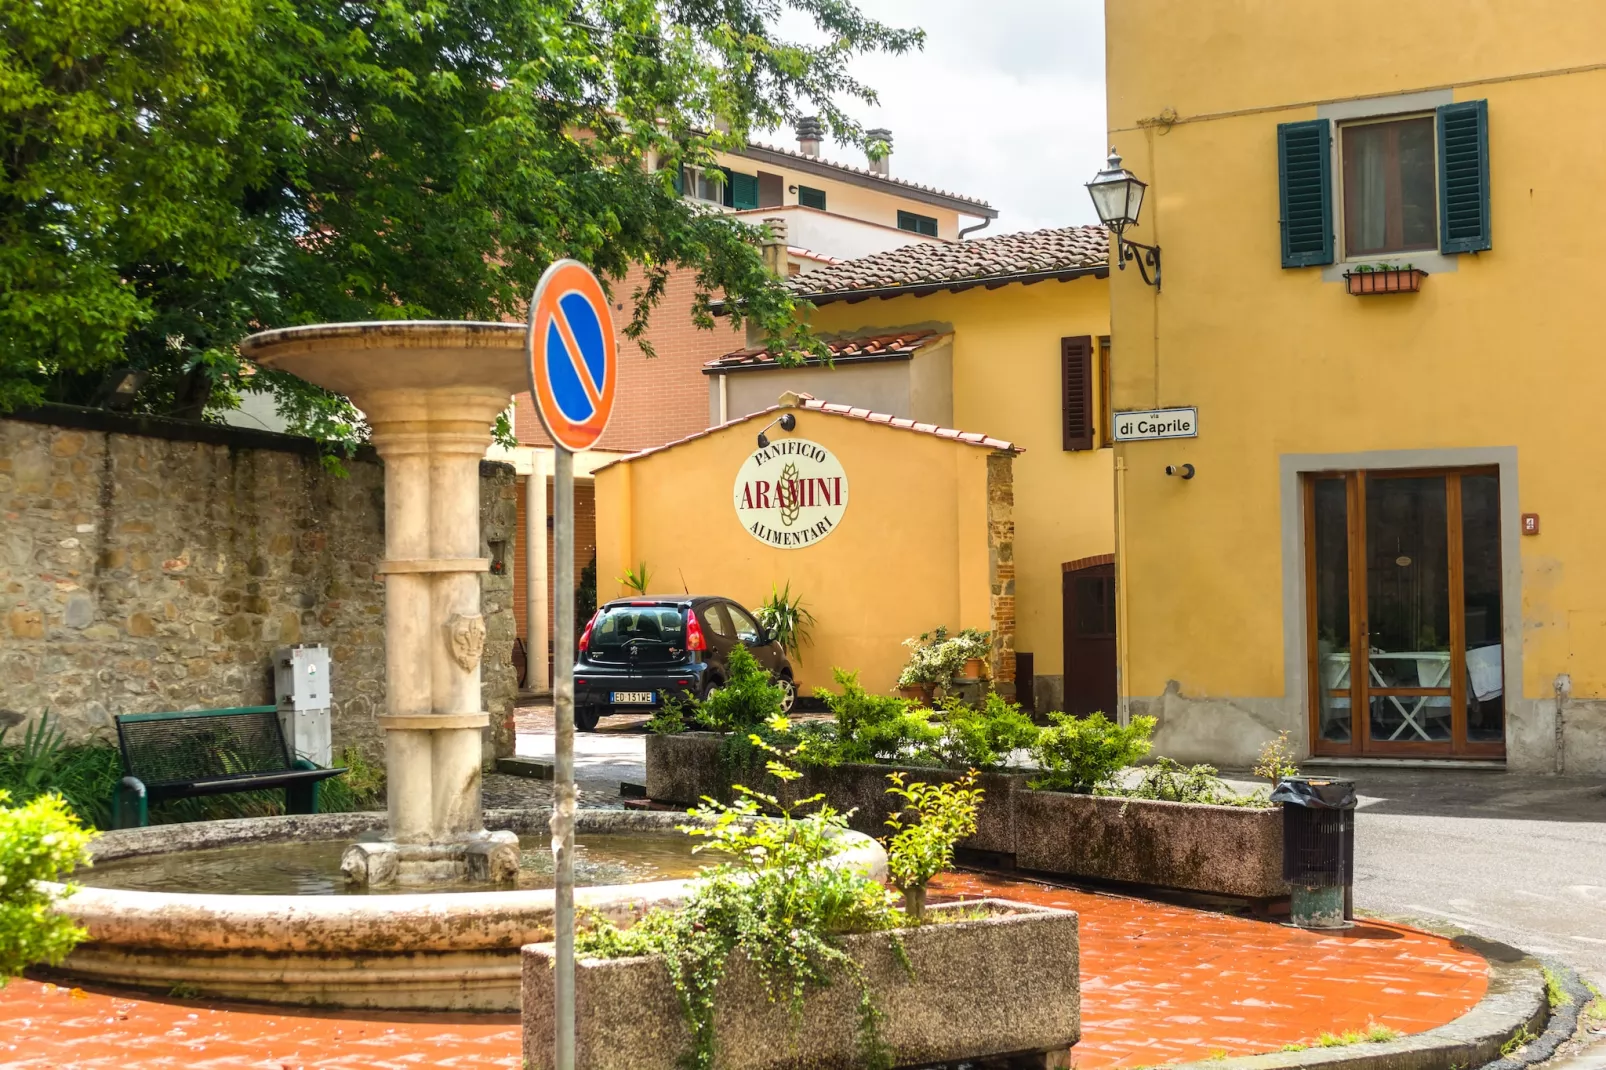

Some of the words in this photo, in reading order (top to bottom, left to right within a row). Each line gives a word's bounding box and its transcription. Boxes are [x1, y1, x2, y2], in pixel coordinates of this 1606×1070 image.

[1120, 423, 1132, 434] di
[1138, 419, 1190, 435] Caprile
[754, 442, 826, 466] PANIFICIO
[740, 477, 842, 510] ARAMINI
[750, 516, 833, 545] ALIMENTARI
